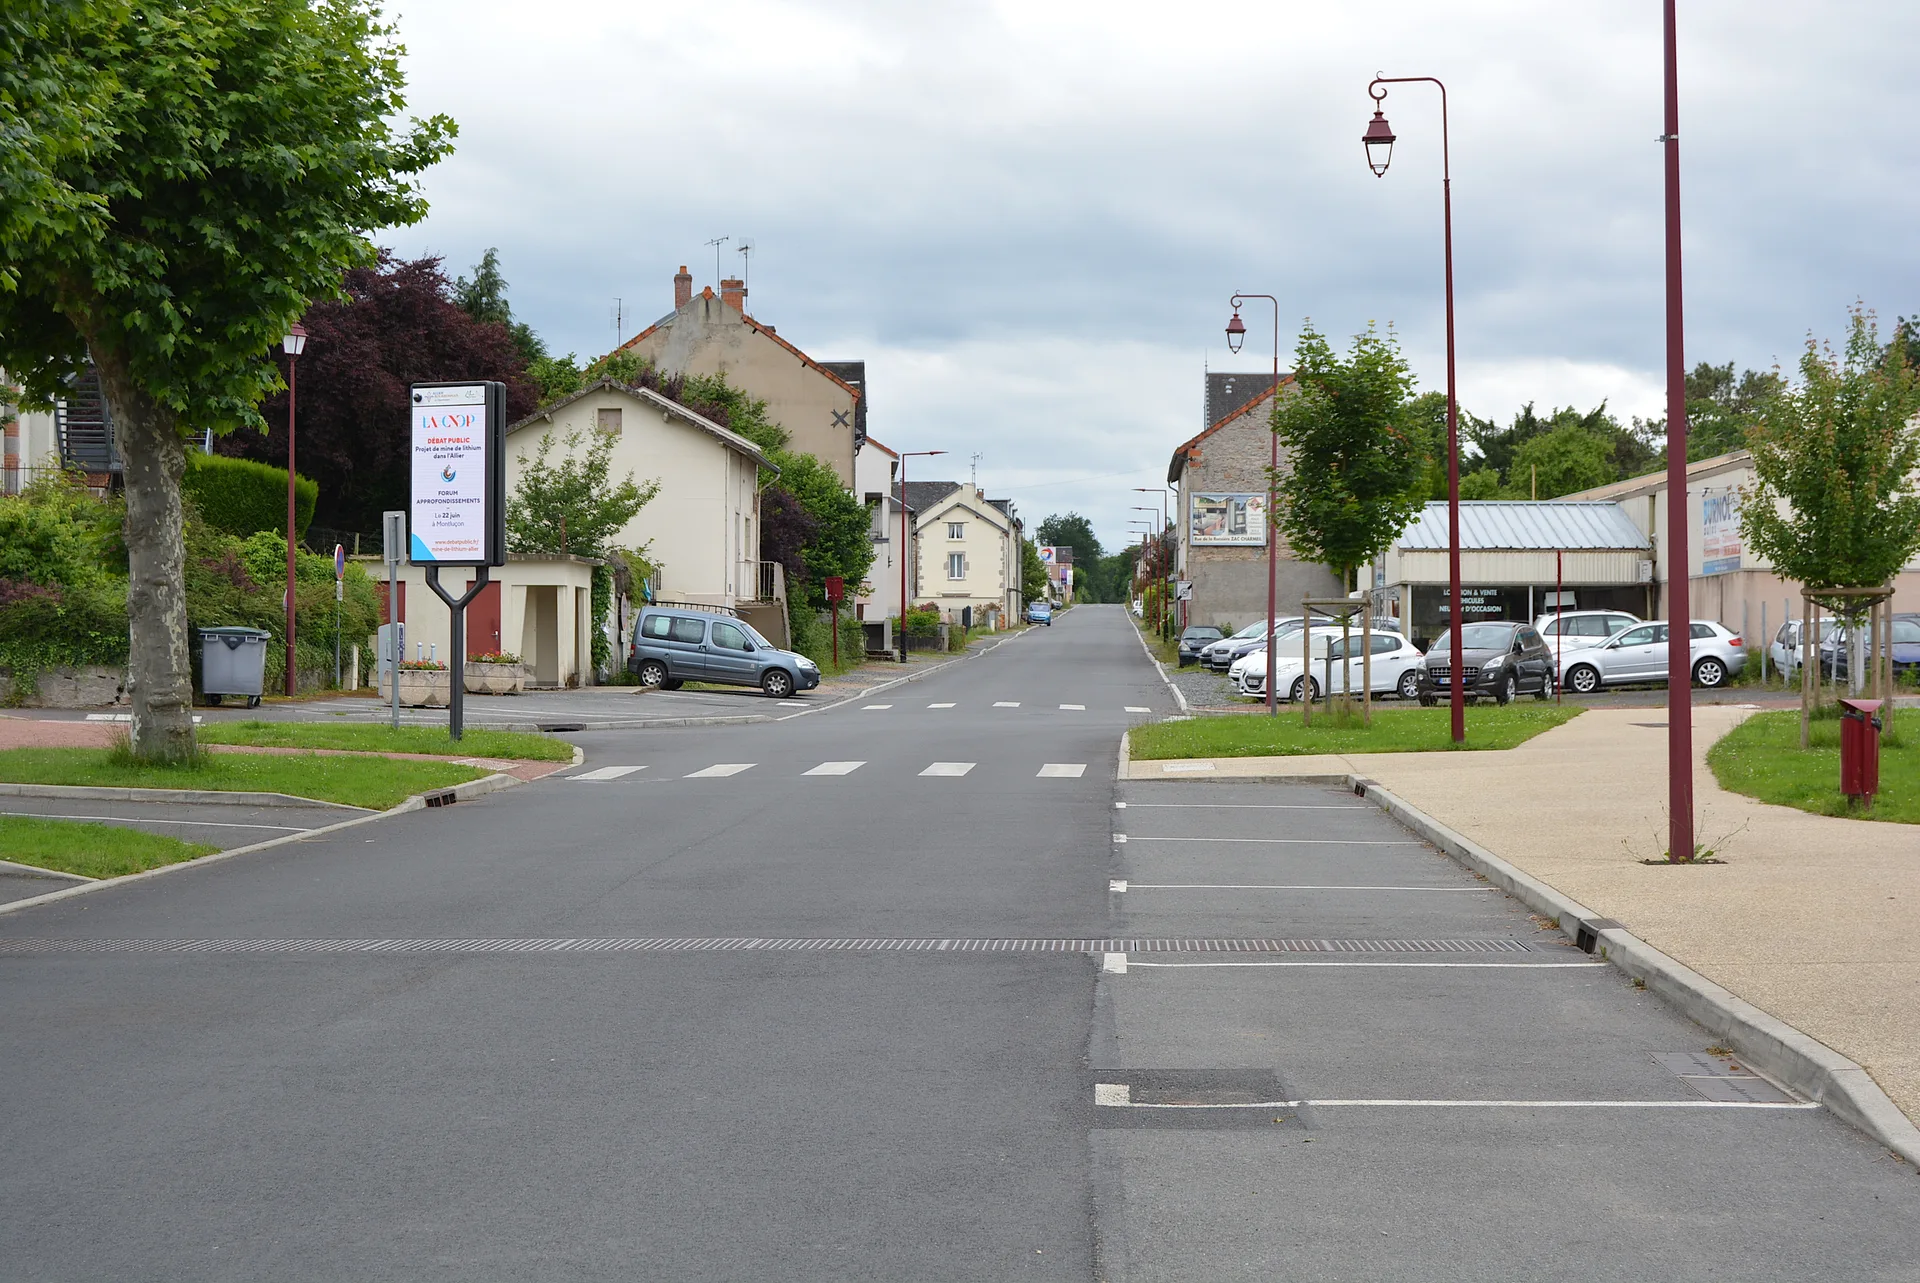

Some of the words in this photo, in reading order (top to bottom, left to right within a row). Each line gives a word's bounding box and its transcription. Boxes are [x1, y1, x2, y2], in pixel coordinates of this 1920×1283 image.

[423, 416, 438, 428] LA
[441, 415, 475, 428] CNDP
[450, 512, 460, 520] juin
